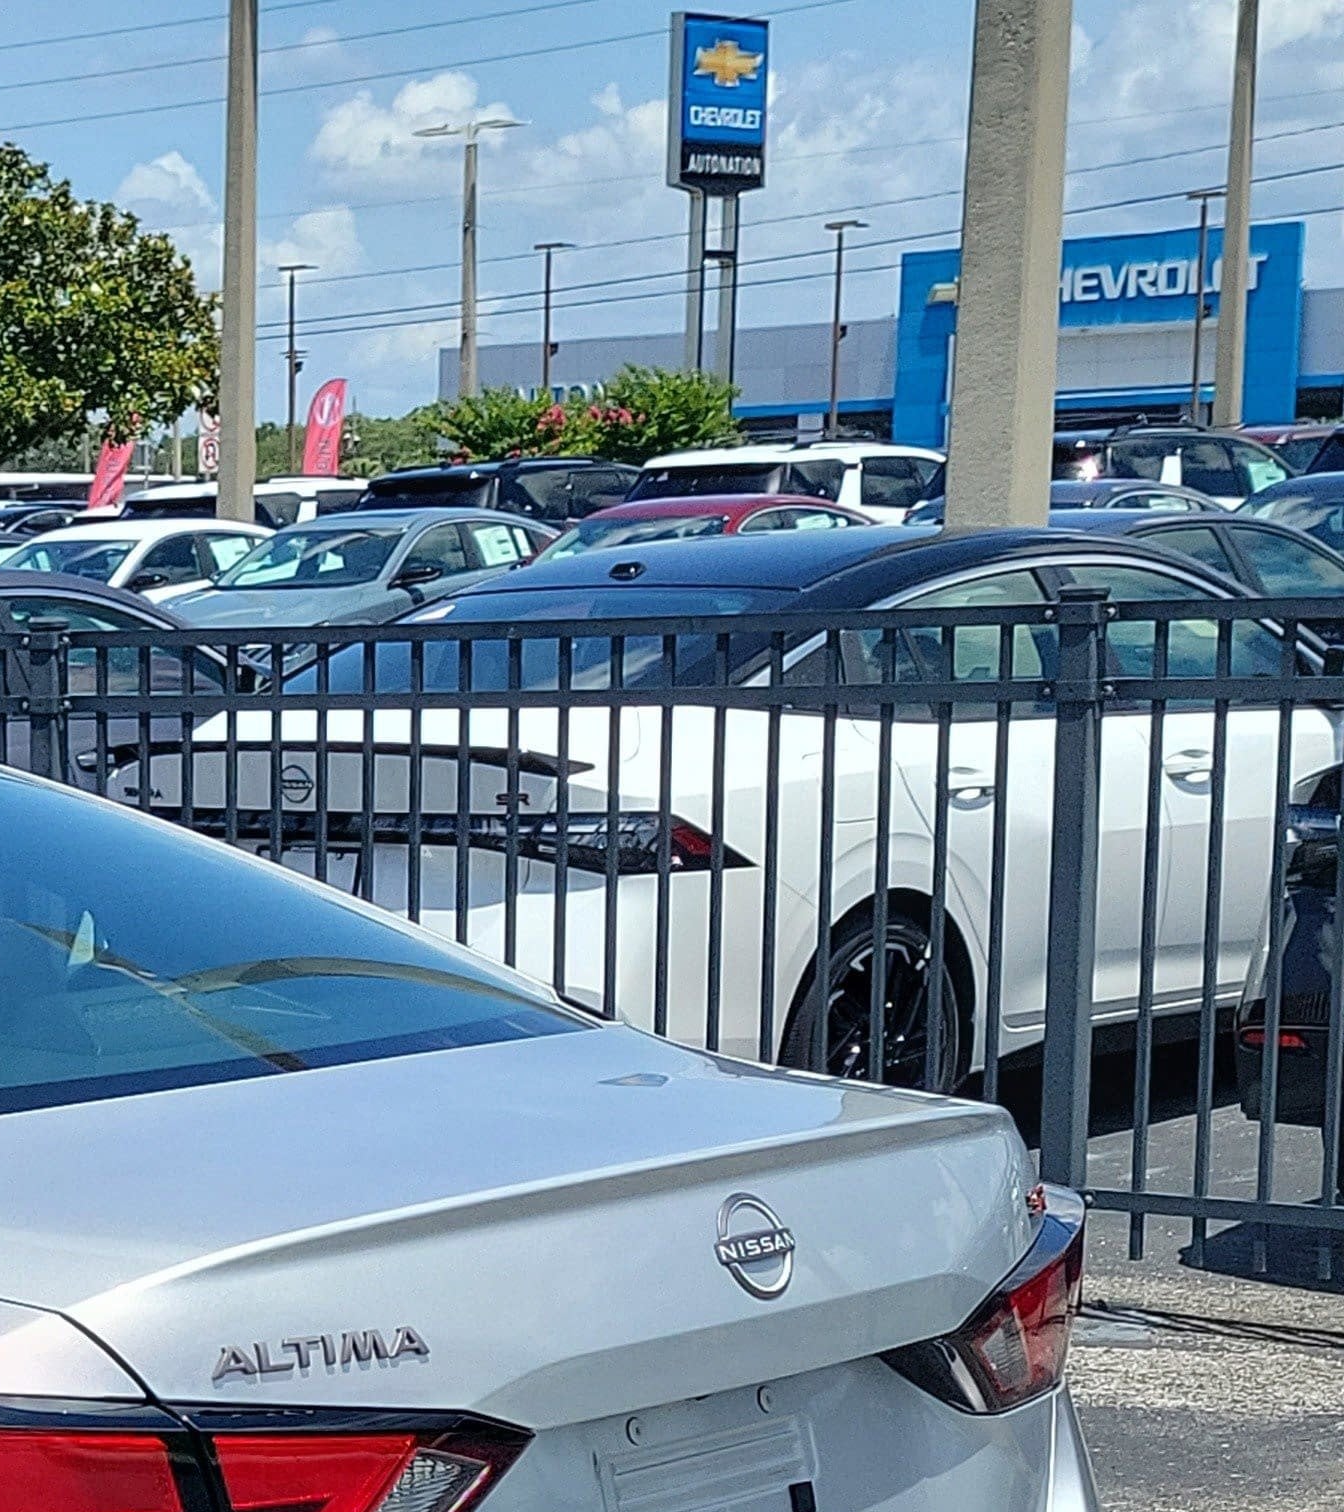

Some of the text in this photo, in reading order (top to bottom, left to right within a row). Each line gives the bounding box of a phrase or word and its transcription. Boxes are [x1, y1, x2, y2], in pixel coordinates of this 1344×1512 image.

[690, 105, 761, 129] CHEVROLET
[688, 153, 761, 175] AUTONATION
[1060, 252, 1268, 302] HEVROLT
[718, 1231, 794, 1261] NISSAN
[211, 1325, 431, 1381] ALTIMA
